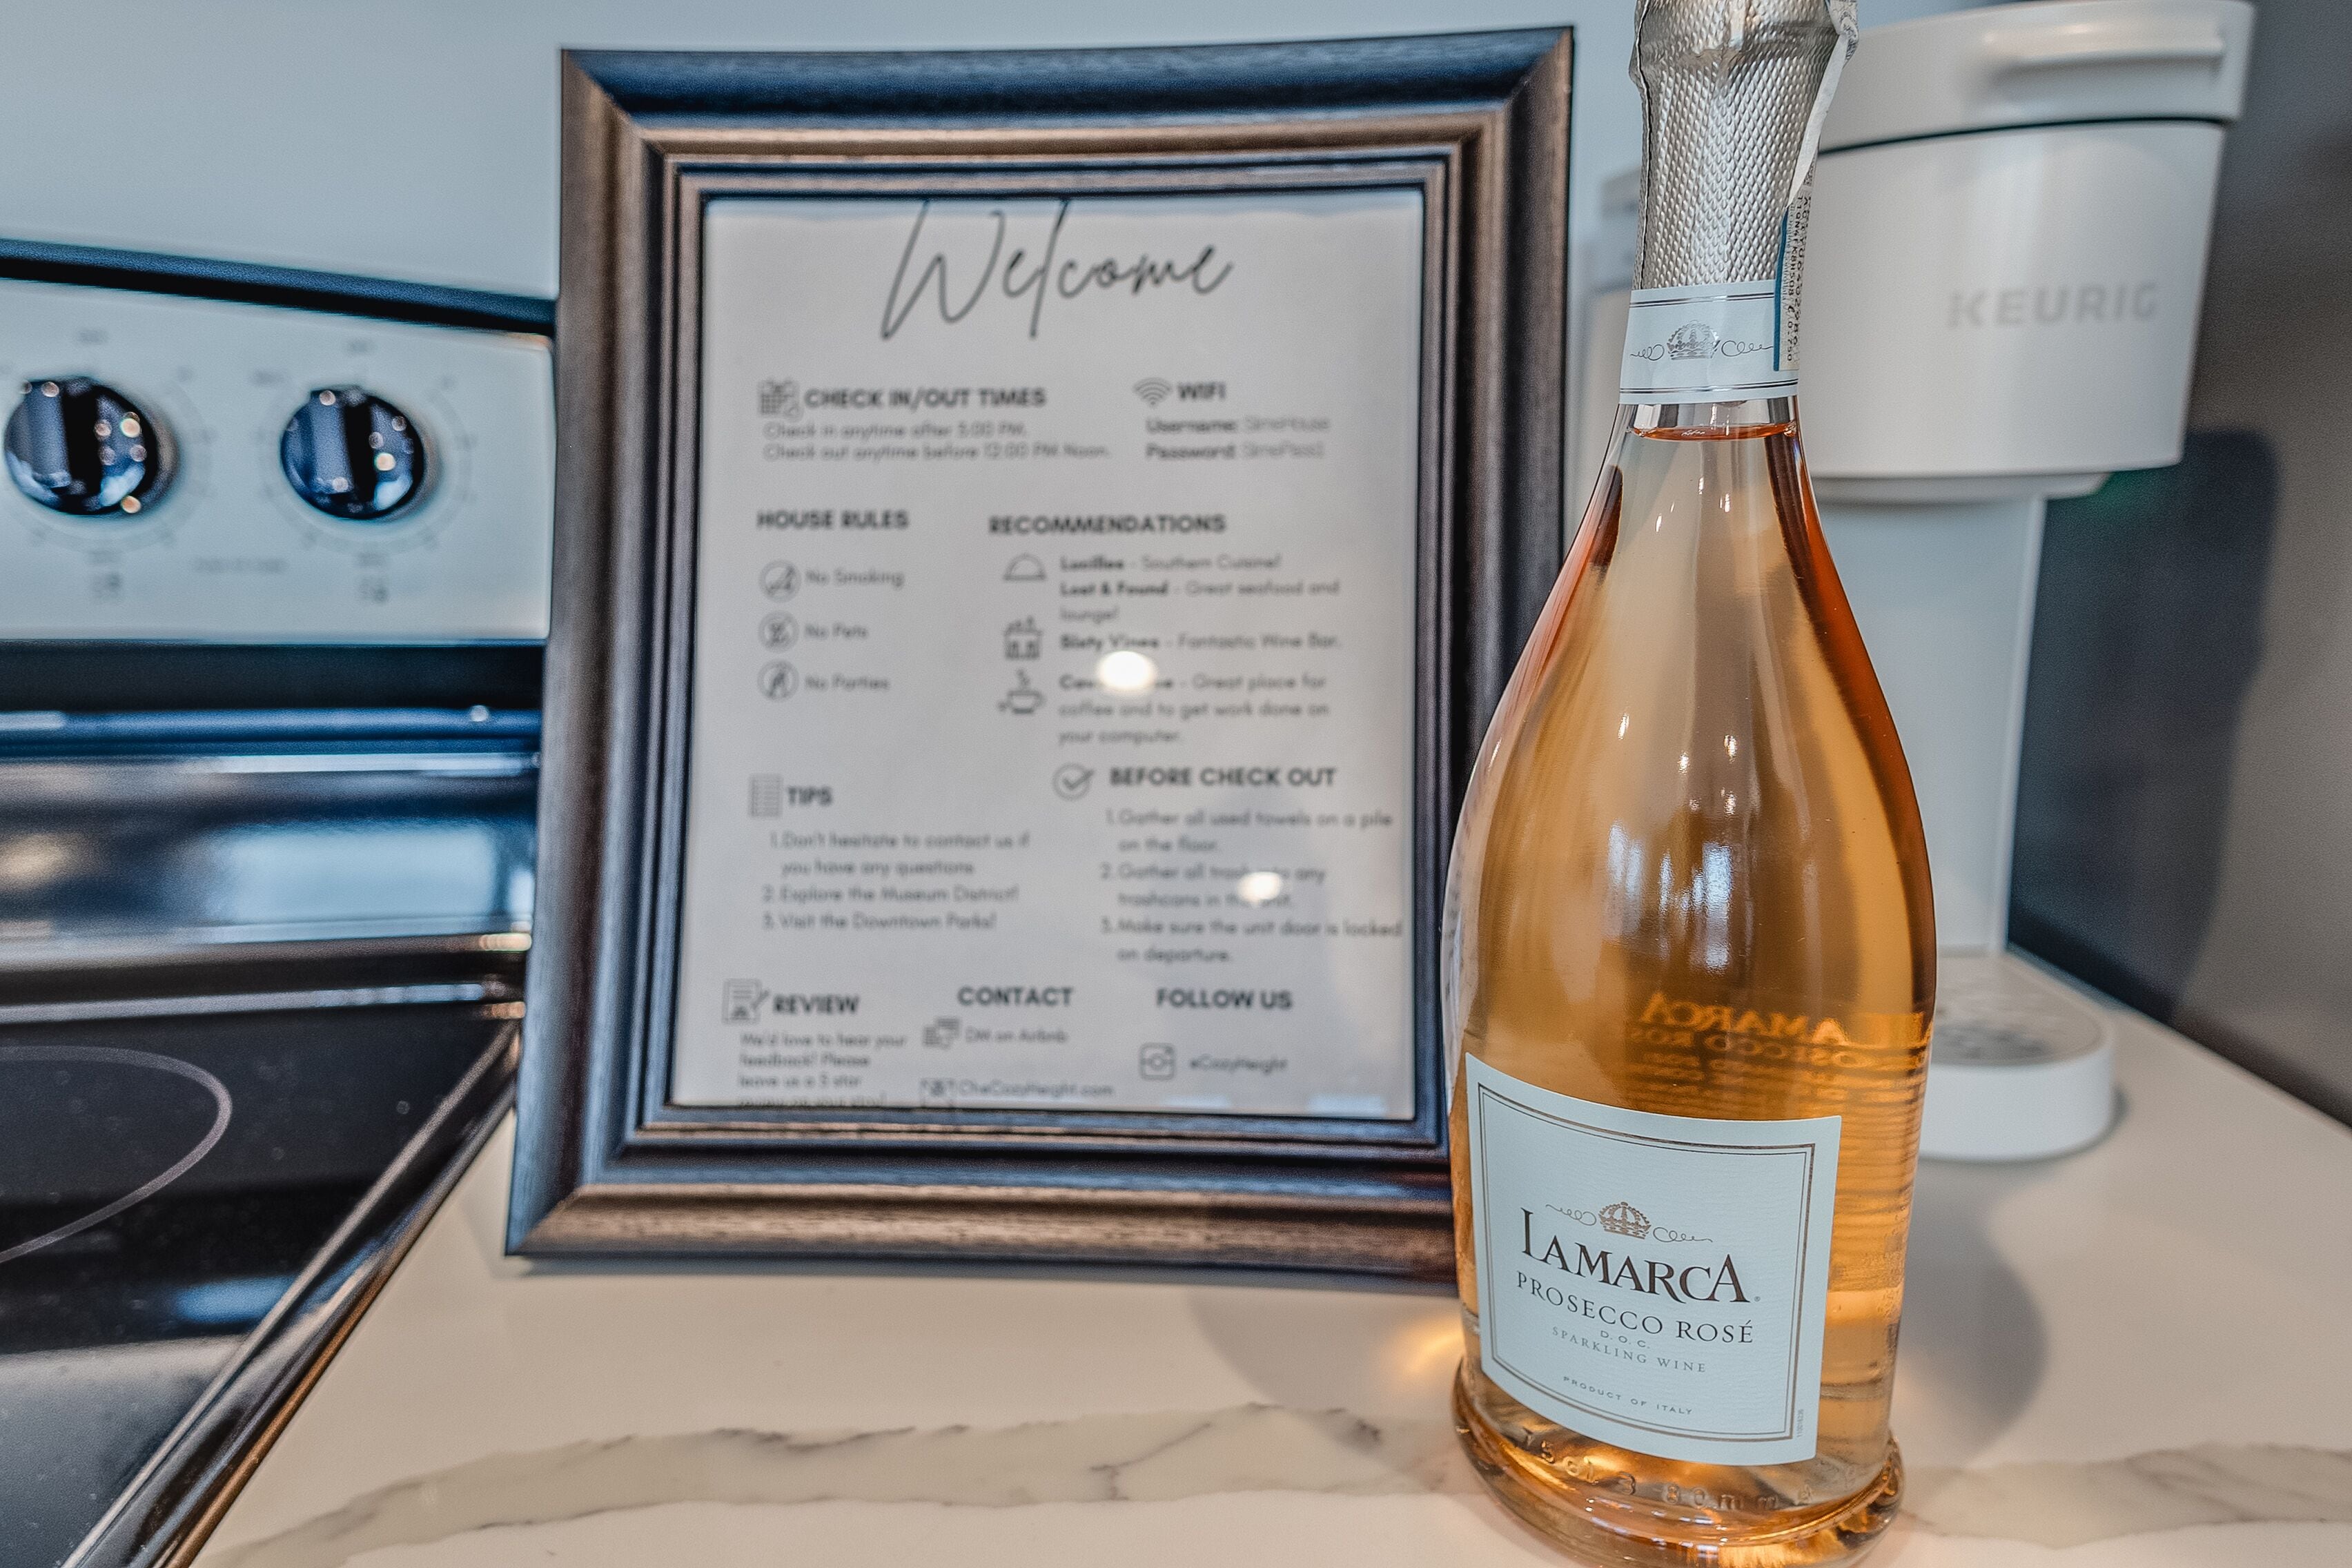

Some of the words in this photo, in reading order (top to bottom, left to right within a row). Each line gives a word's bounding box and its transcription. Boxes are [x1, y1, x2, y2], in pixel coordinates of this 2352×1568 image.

[880, 197, 1235, 340] Welcome
[1947, 282, 2157, 330] KEURIG
[803, 387, 882, 410] CHECK
[890, 388, 970, 412] IN/OUT
[978, 387, 1047, 409] TIMES
[1177, 382, 1226, 402] WIFI
[763, 422, 815, 440] Check
[841, 422, 903, 444] anytime
[910, 421, 952, 438] after
[763, 443, 815, 462] Check
[821, 445, 847, 460] out
[854, 444, 917, 465] anytime
[923, 442, 979, 460] before
[756, 509, 833, 529] HOUSE
[841, 509, 910, 529] RULES
[988, 513, 1226, 535] RECOMMENDATIONS
[805, 567, 827, 584] No
[833, 567, 905, 591] Smoking
[1059, 580, 1096, 597] Lost
[1117, 580, 1170, 596] Found
[1185, 580, 1233, 596] Great
[1238, 580, 1304, 596] seafood
[1308, 580, 1340, 596] and
[804, 623, 827, 640] No
[832, 622, 869, 640] Pets
[1178, 633, 1255, 651] Fantastic
[1262, 633, 1303, 649] Wine
[804, 674, 827, 691] No
[831, 673, 891, 692] Parties
[1192, 673, 1245, 690] Great
[1248, 672, 1297, 693] place
[1302, 672, 1326, 689] for
[1059, 701, 1115, 718] coffee
[1120, 701, 1152, 718] and
[1157, 701, 1175, 717] to
[1180, 702, 1209, 721] get
[1215, 700, 1253, 717] work
[1260, 700, 1302, 718] done
[1308, 703, 1330, 717] on
[1059, 730, 1093, 747] your
[1098, 728, 1181, 747] computer.
[1110, 767, 1193, 787] BEFORE
[1199, 767, 1281, 787] CHECK
[1287, 767, 1337, 787] OUT
[788, 786, 832, 806] TIPS
[1117, 809, 1179, 827] Gather
[1184, 809, 1204, 826] all
[1210, 809, 1251, 827] used
[1255, 810, 1311, 827] towels
[1316, 812, 1338, 827] on
[1343, 812, 1355, 827] a
[1360, 810, 1393, 832] pile
[830, 831, 898, 849] hesitate
[903, 832, 921, 849] to
[925, 832, 992, 849] contact
[995, 835, 1014, 849] us
[1117, 839, 1140, 853] on
[1145, 836, 1172, 853] the
[781, 861, 810, 879] you
[814, 859, 856, 876] have
[861, 861, 890, 879] any
[1117, 863, 1179, 881] Gather
[1184, 863, 1204, 880] all
[1294, 865, 1326, 885] any
[780, 885, 843, 905] Explore
[847, 884, 876, 902] the
[881, 884, 948, 903] Museum
[1117, 891, 1200, 908] trashcans
[1207, 892, 1221, 908] in
[820, 912, 849, 930] the
[852, 911, 943, 930] Downtown
[1117, 918, 1164, 934] Make
[1169, 921, 1204, 935] sure
[1210, 918, 1237, 935] the
[1244, 919, 1276, 936] unit
[1280, 919, 1322, 937] door
[1325, 920, 1338, 937] is
[1344, 919, 1403, 938] locked
[1117, 948, 1140, 963] on
[773, 994, 861, 1016] REVIEW
[957, 986, 1074, 1007] CONTACT
[1156, 988, 1255, 1010] FOLLOW
[1260, 989, 1293, 1011] US
[874, 1035, 906, 1052] your
[995, 1030, 1013, 1043] on
[1517, 1271, 1664, 1335] PROSECCO
[1676, 1319, 1754, 1344] ROSÉ
[1552, 1326, 1648, 1364] SPARKLING
[1656, 1357, 1707, 1373] WINE
[1562, 1375, 1623, 1401] PRODUCT
[1630, 1398, 1648, 1408] OF
[1656, 1403, 1694, 1415] ITALY
